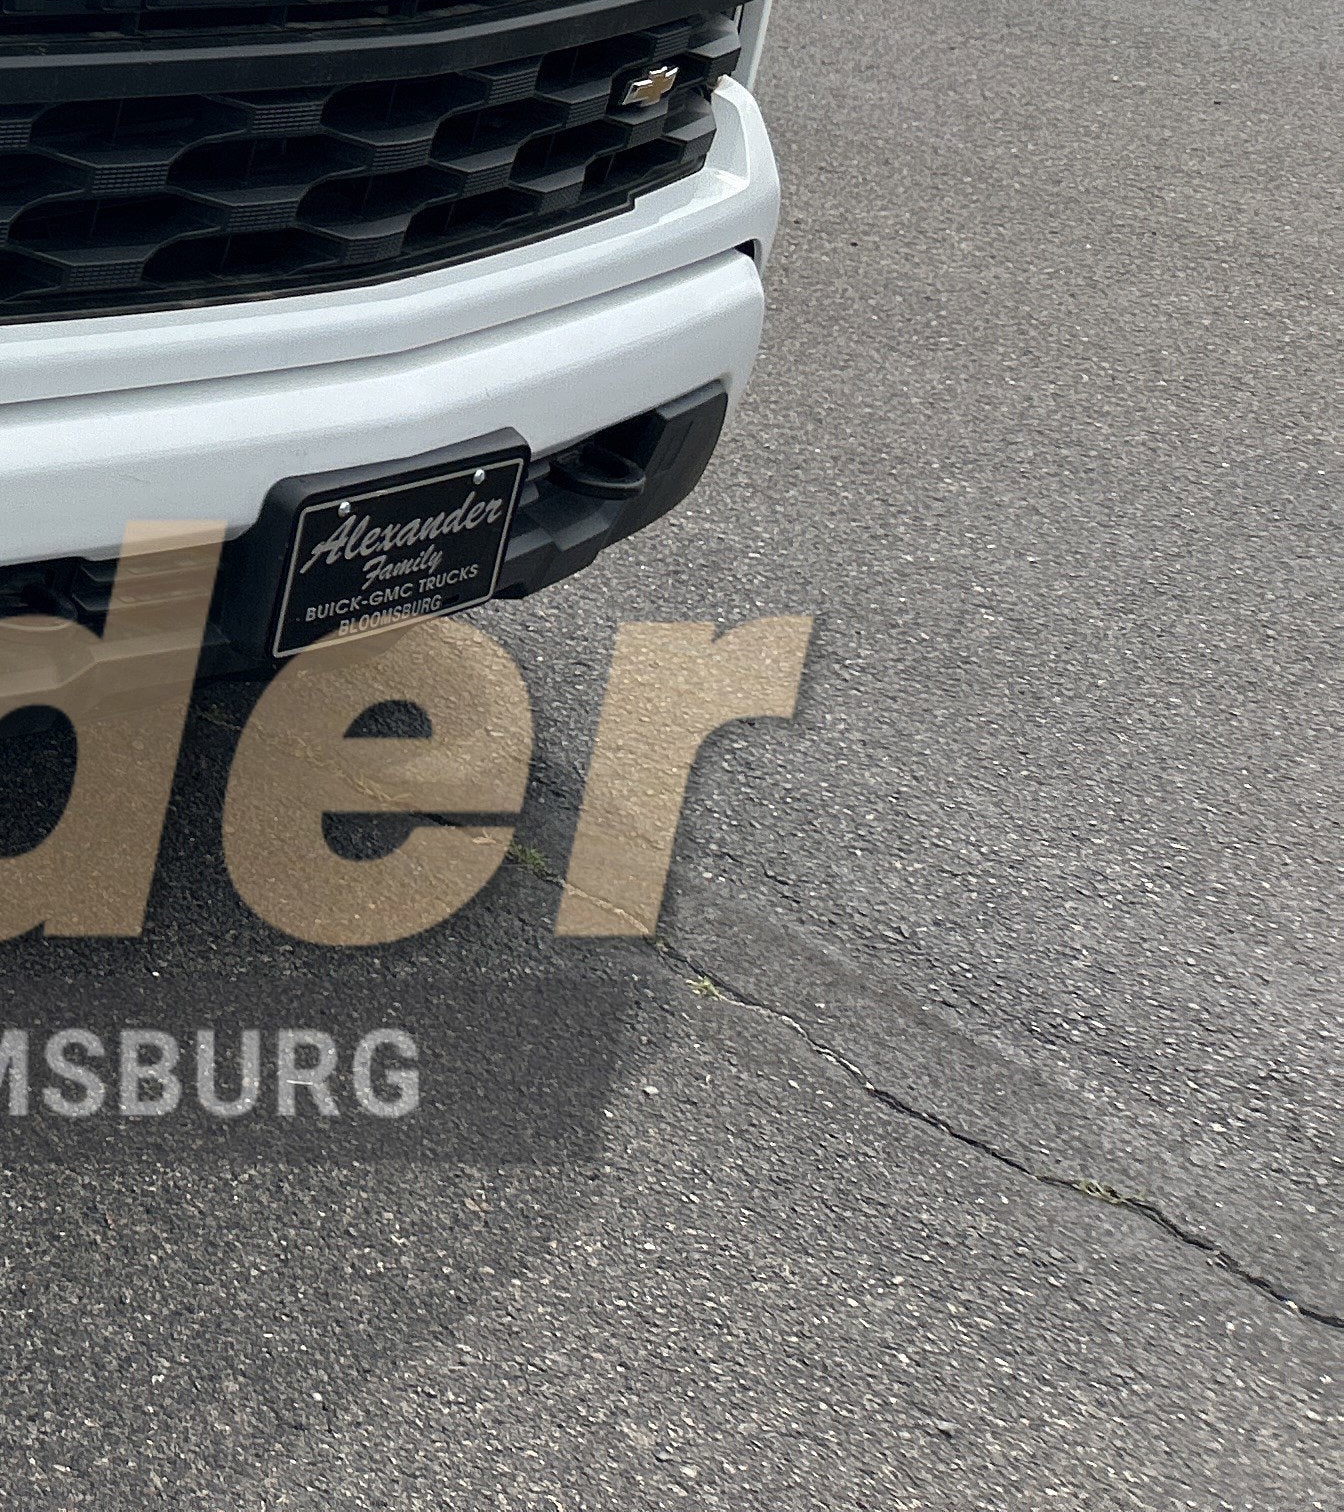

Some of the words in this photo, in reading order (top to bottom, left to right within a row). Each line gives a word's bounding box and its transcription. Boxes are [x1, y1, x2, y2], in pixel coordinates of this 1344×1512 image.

[299, 491, 503, 574] Alexander
[305, 584, 413, 622] BUICK-GMC
[419, 564, 480, 594] TRUCKS
[361, 544, 443, 590] Family
[338, 594, 443, 637] BLOOMSBURG
